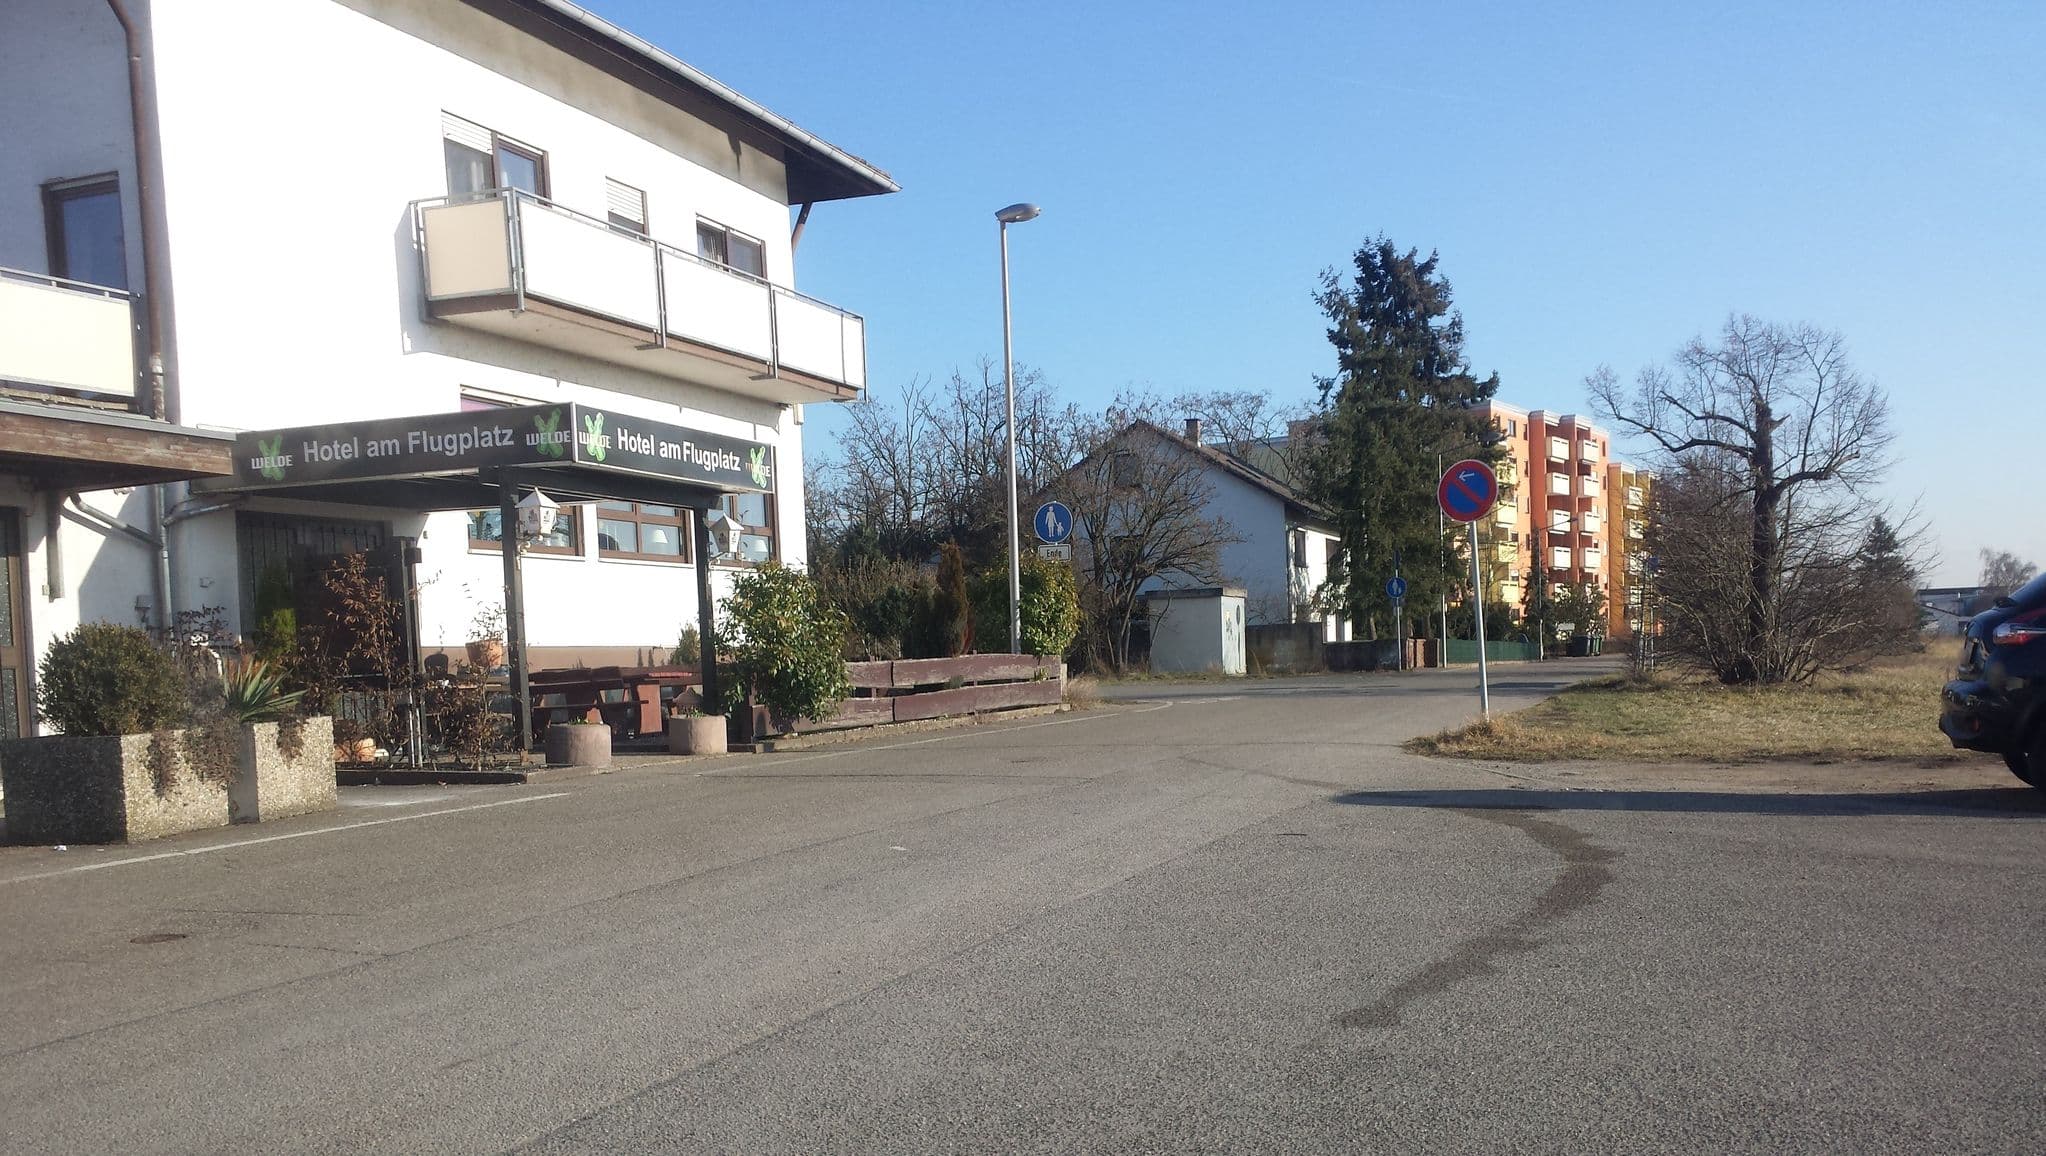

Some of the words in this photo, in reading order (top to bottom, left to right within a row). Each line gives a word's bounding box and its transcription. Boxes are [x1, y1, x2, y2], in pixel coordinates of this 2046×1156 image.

[303, 437, 359, 463] Hotel
[366, 437, 401, 457] am
[407, 425, 515, 456] Flugplatz
[526, 430, 571, 446] WELDE
[579, 431, 611, 449] WDE
[617, 427, 655, 456] Hotel
[659, 441, 682, 461] am
[683, 440, 741, 472] Flugplatz
[251, 454, 294, 469] WELDE
